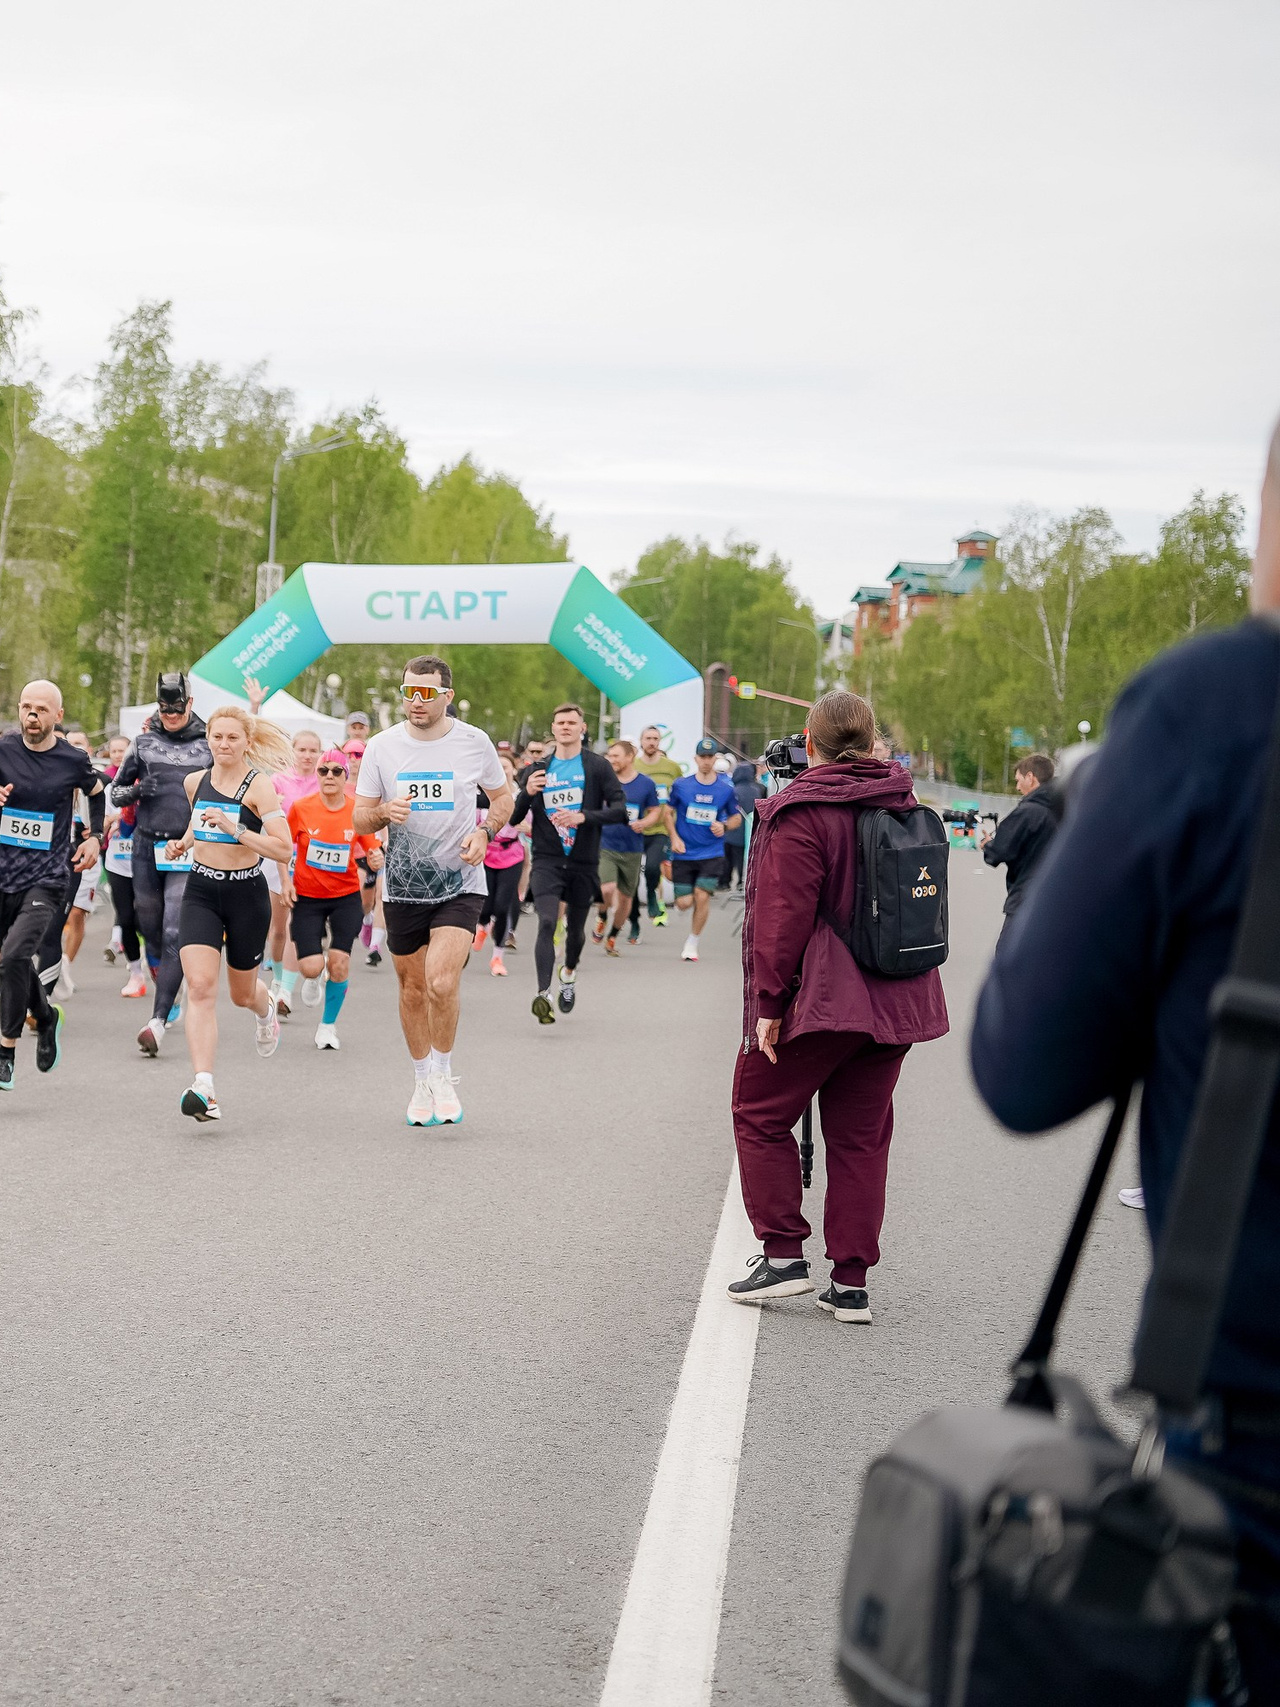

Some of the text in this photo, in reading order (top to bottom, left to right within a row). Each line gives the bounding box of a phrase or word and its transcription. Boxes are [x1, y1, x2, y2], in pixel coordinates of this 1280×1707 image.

[365, 590, 508, 621] СТАРТ
[409, 784, 442, 798] 818
[551, 792, 574, 804] 696
[10, 820, 41, 837] 568
[118, 842, 134, 852] 56
[316, 850, 340, 863] 713
[197, 865, 226, 880] PRO
[229, 866, 261, 880] NIKE
